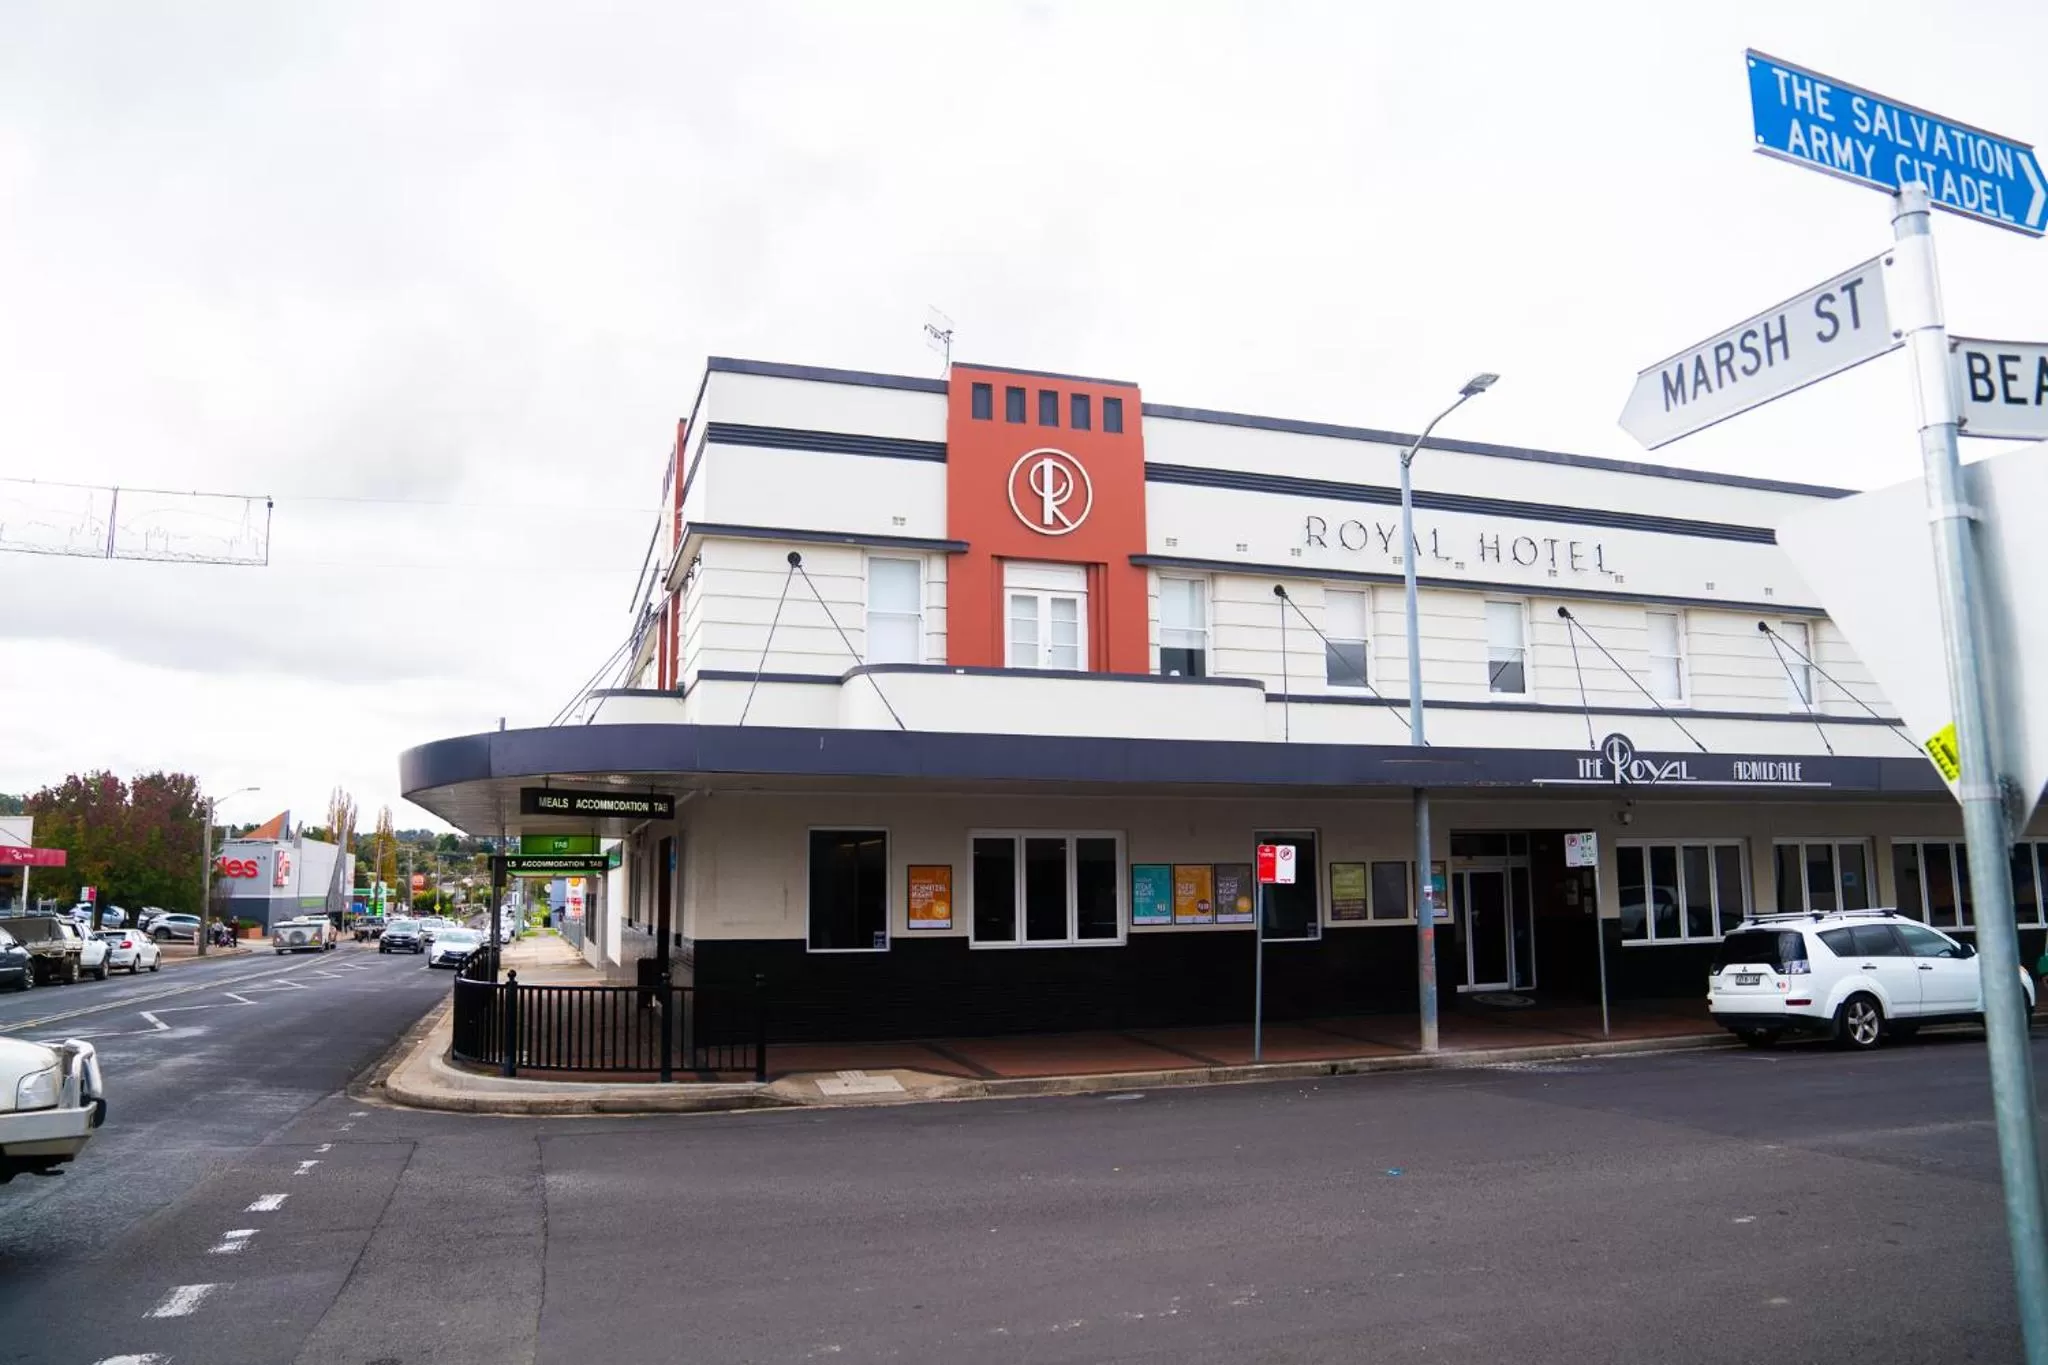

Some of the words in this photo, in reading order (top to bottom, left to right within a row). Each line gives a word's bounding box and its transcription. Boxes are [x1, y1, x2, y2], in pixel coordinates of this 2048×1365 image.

[1772, 68, 1836, 122] THE
[1851, 97, 2016, 181] SALVATION
[1787, 119, 1876, 178] ARMY
[1895, 153, 2016, 222] CITADEL
[1661, 315, 1791, 413] MARSH
[1814, 277, 1865, 343] ST
[1480, 532, 1617, 575] HOTEL
[1577, 758, 1604, 779] THE
[1733, 761, 1802, 782] ARMIDALE
[539, 797, 569, 809] MEALS
[576, 799, 649, 812] ACCOMMODATION
[654, 802, 668, 813] TAB
[554, 841, 568, 849] TAB
[522, 860, 585, 868] ACCOMMODATION
